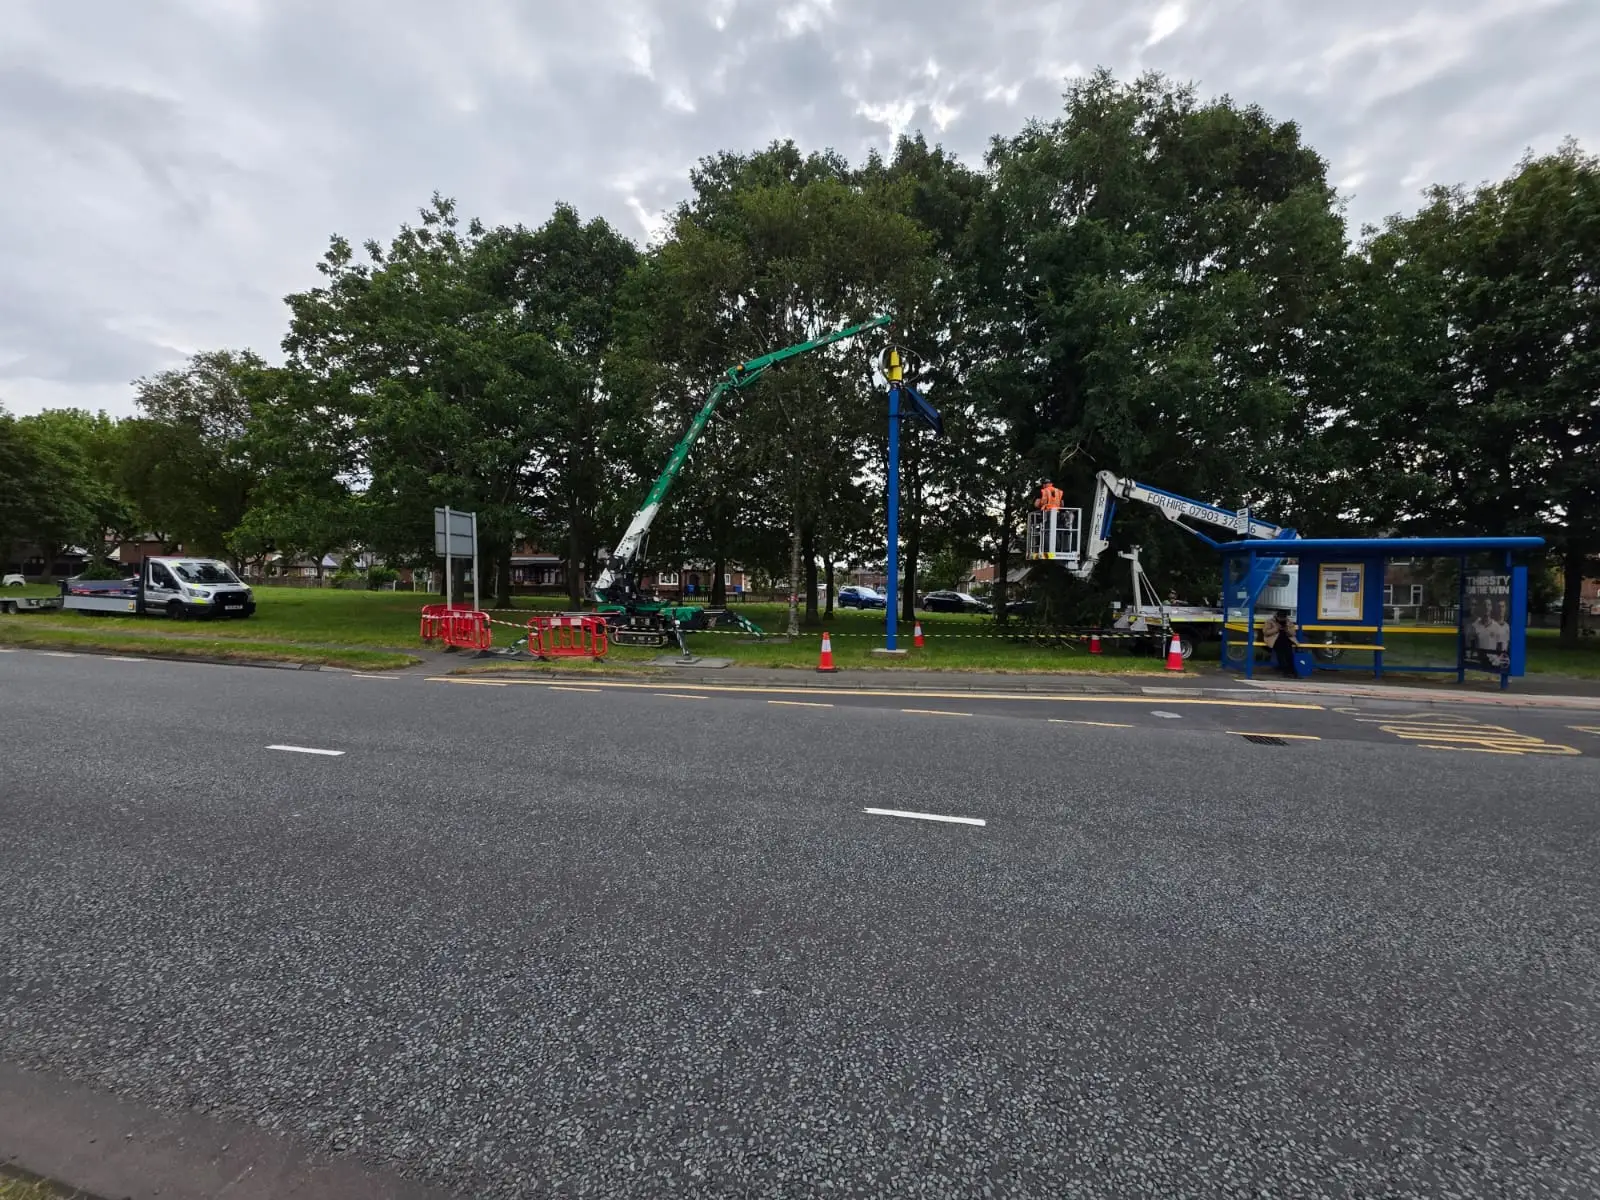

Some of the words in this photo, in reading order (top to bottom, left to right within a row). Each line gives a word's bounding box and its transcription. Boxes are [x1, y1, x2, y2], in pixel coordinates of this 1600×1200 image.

[1147, 492, 1165, 507] FOR
[1167, 499, 1187, 513] HIRE
[1189, 506, 1219, 523] 07903
[1223, 516, 1256, 534] 3786
[1465, 575, 1511, 586] THIRSTY
[1489, 585, 1510, 595] WIN
